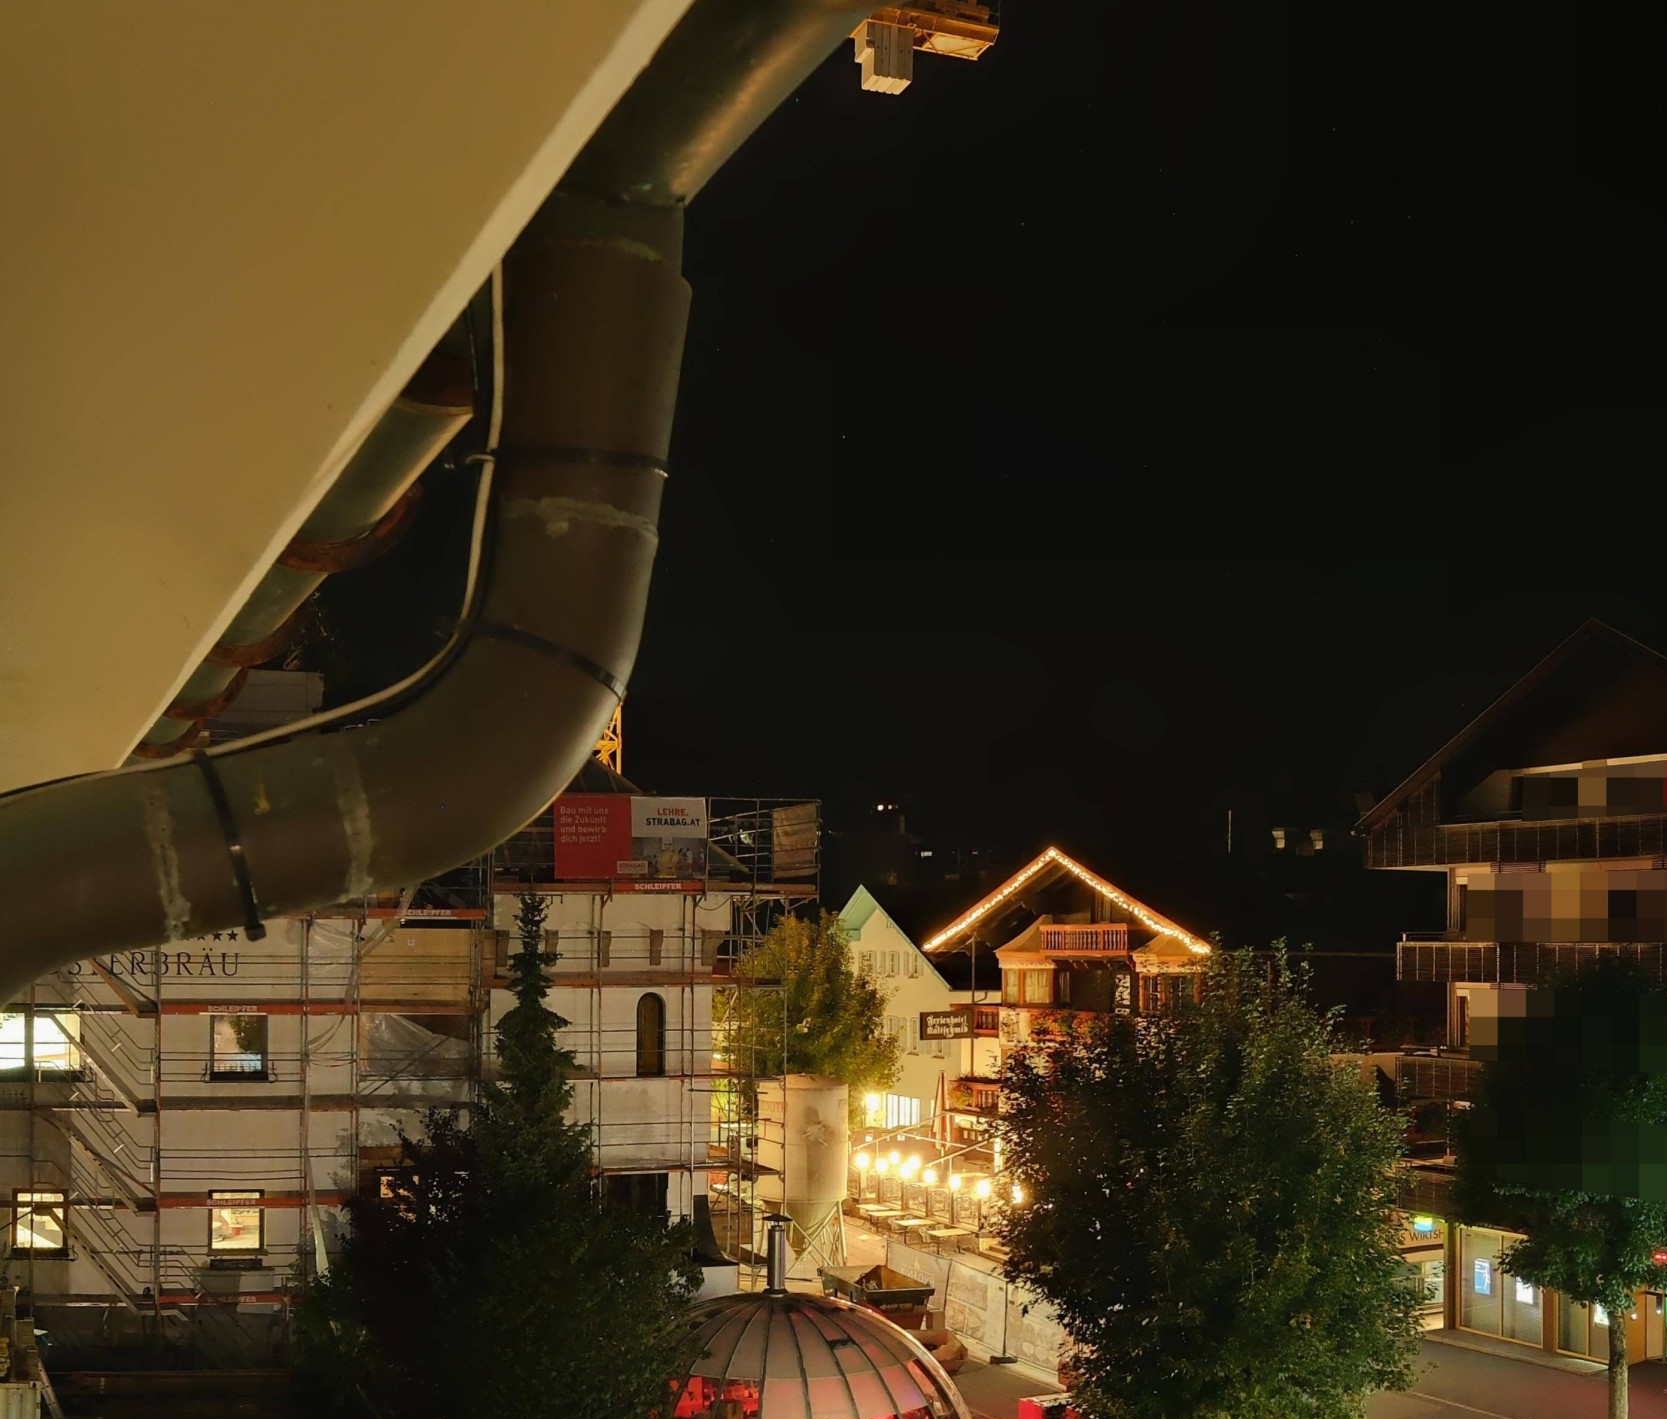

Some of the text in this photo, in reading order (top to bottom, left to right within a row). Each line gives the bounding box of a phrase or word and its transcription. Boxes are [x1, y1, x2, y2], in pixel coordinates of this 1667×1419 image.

[560, 806, 575, 815] Bau
[578, 806, 592, 815] mit
[657, 807, 689, 817] LEHRE.
[560, 815, 573, 824] die
[645, 817, 701, 827] STRABAG.AT
[560, 825, 575, 833] und
[560, 834, 577, 843] dich
[634, 882, 682, 891] SCHLEIPFER
[207, 1005, 258, 1013] SCHLEIPFER
